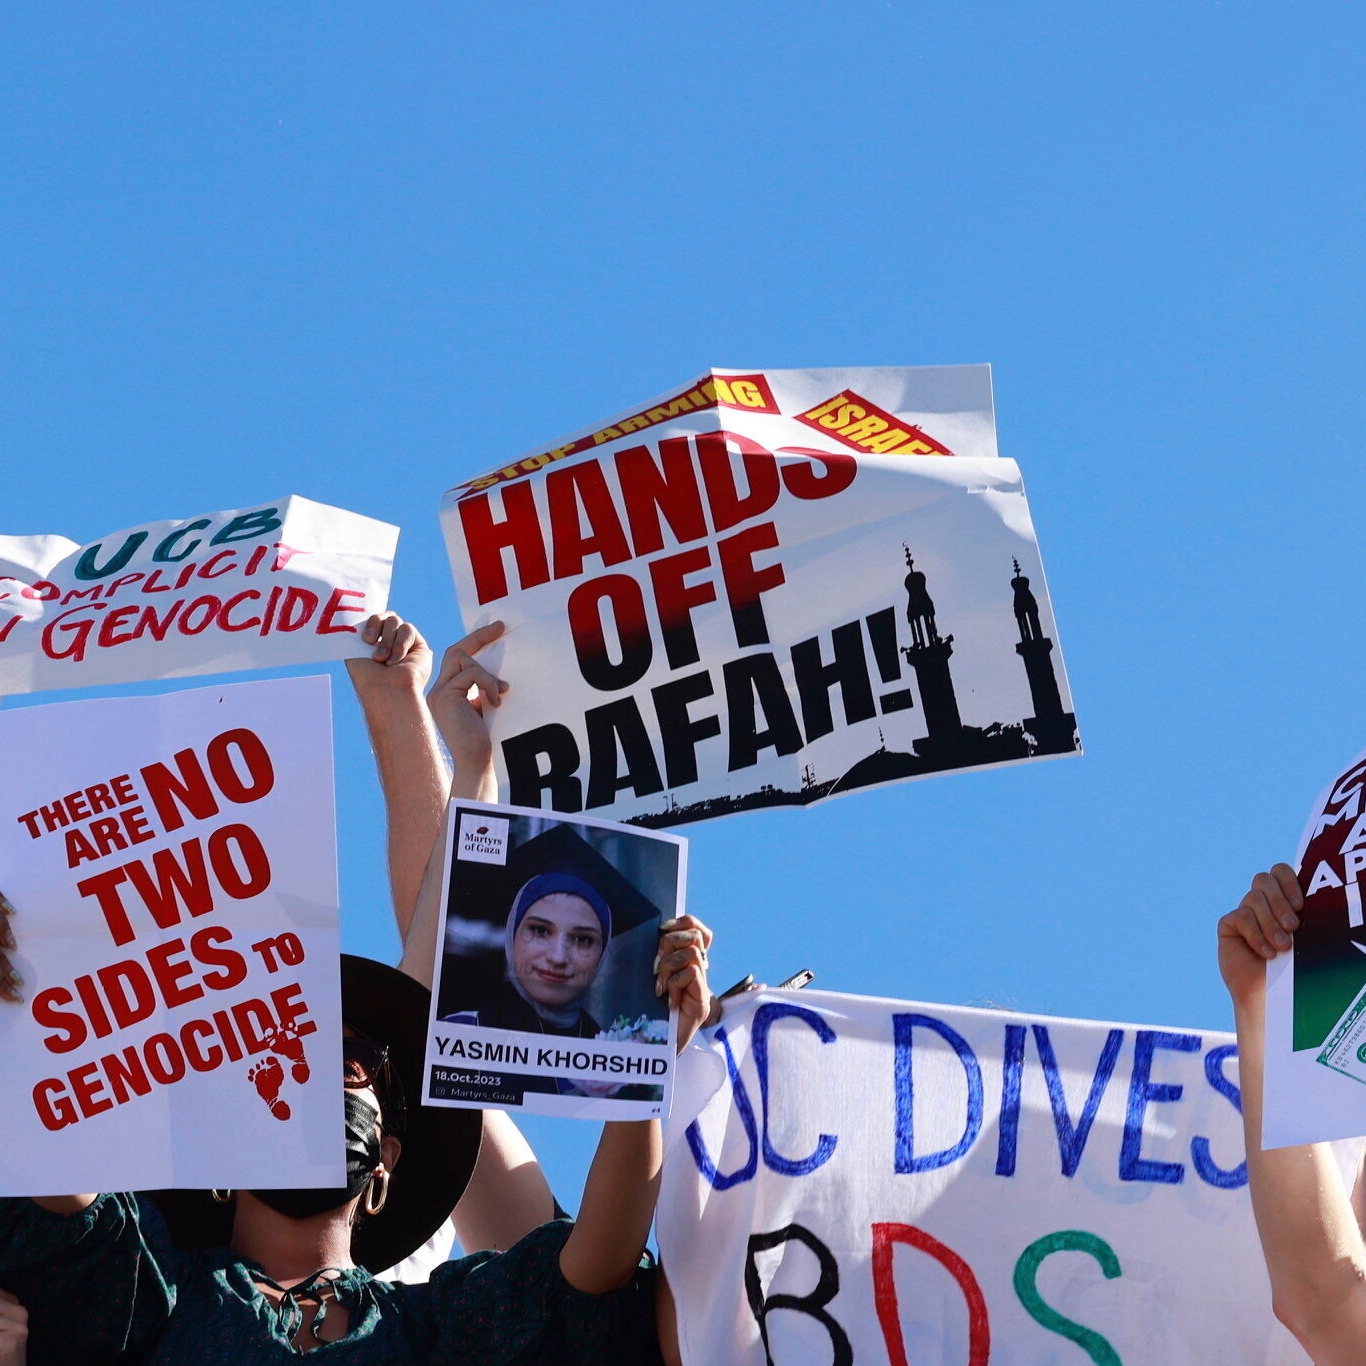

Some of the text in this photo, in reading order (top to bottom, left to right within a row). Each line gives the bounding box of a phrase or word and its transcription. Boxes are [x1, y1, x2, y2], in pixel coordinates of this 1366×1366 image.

[469, 378, 767, 491] STOP ARMING
[75, 507, 282, 580] UCB
[41, 585, 366, 662] GENOCIDE
[567, 522, 786, 691] OFF
[501, 606, 914, 812] RAFAH!
[17, 774, 139, 840] THERE
[64, 727, 275, 869] ARE NO
[464, 832, 503, 846] Martyrs
[76, 823, 272, 948] TWO
[464, 843, 501, 855] of Gaza
[31, 925, 305, 1054] SIDES TO
[31, 982, 317, 1132] GENOCIDE
[434, 1070, 502, 1086] 18.Oct.2023
[435, 1036, 669, 1076] YASMIN KHORSHID
